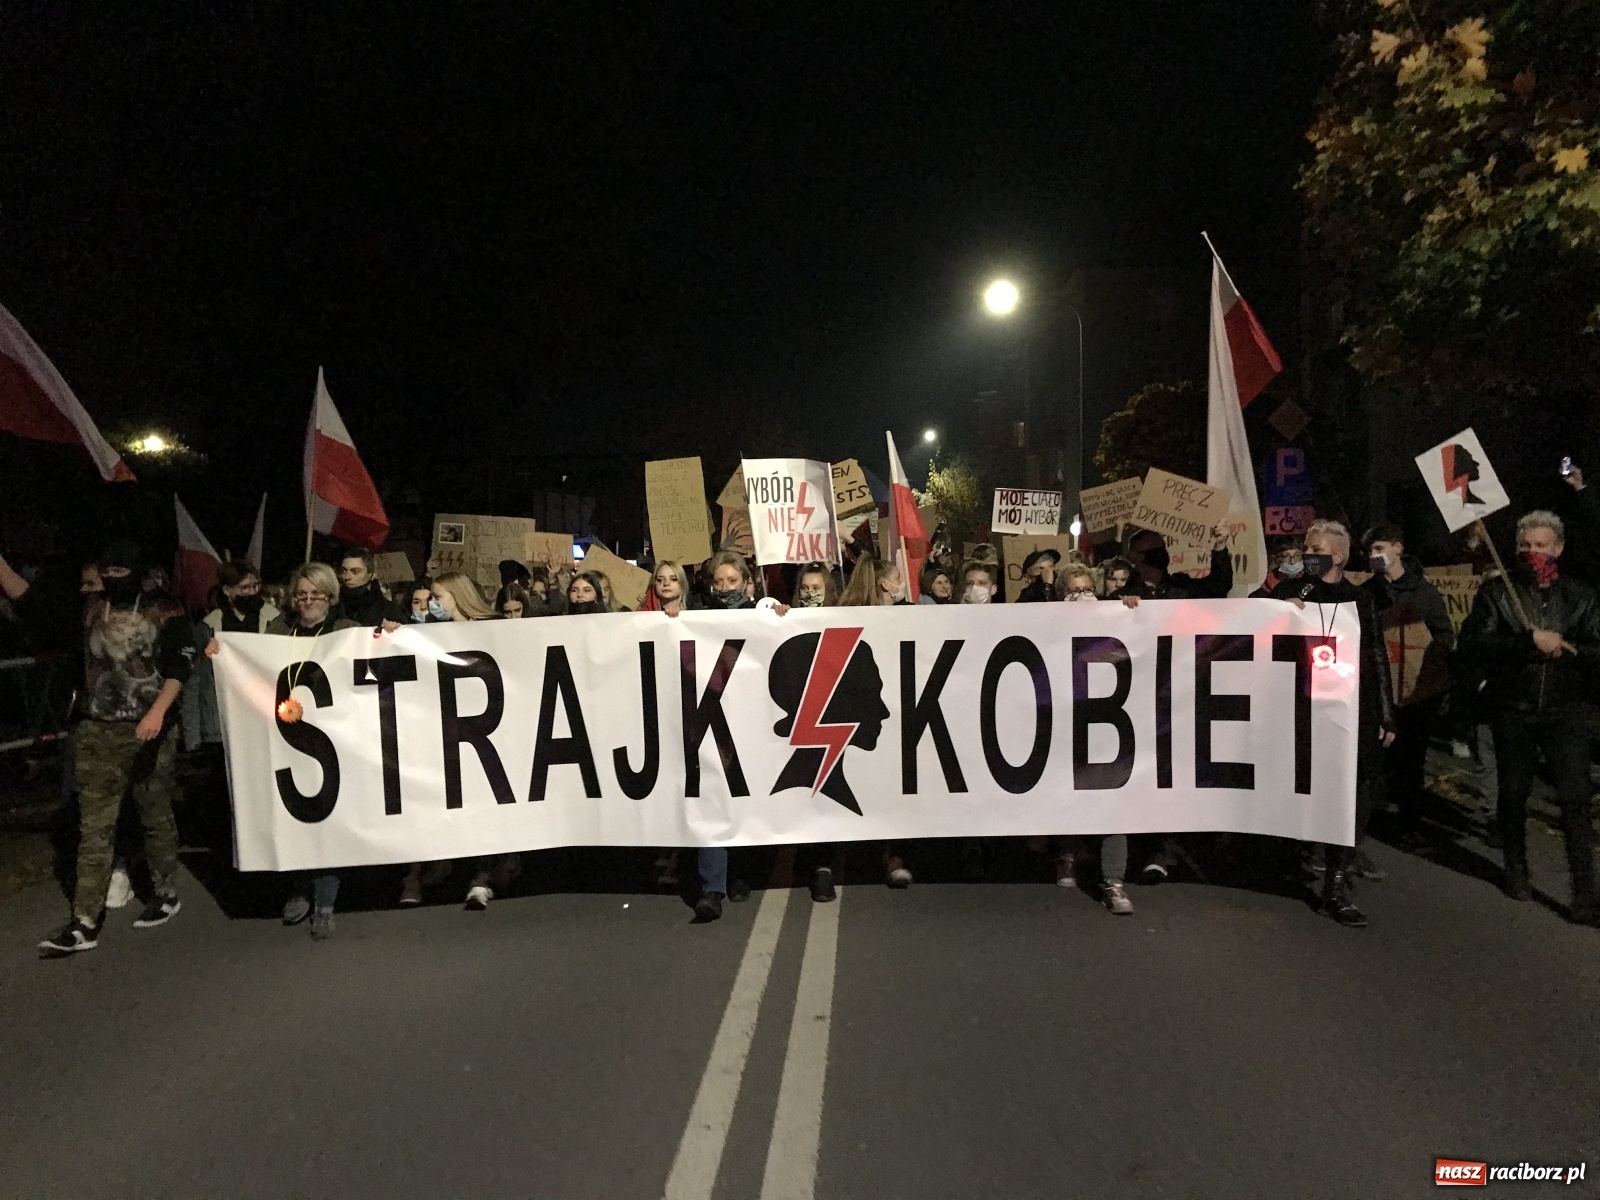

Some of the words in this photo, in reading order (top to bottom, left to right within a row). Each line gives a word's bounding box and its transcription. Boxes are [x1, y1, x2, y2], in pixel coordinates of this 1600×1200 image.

[832, 465, 851, 479] EN
[1276, 448, 1304, 487] P
[833, 485, 869, 504] STS
[999, 490, 1029, 506] MOJE
[1031, 492, 1061, 508] CIAŁO
[1162, 478, 1215, 509] PRECZ
[767, 507, 796, 533] NIE
[997, 507, 1022, 525] MÓJ
[1024, 509, 1059, 525] WYBÓR
[785, 533, 838, 562] ZAKA
[275, 639, 750, 824] STRAJK
[899, 634, 1337, 795] KOBIET
